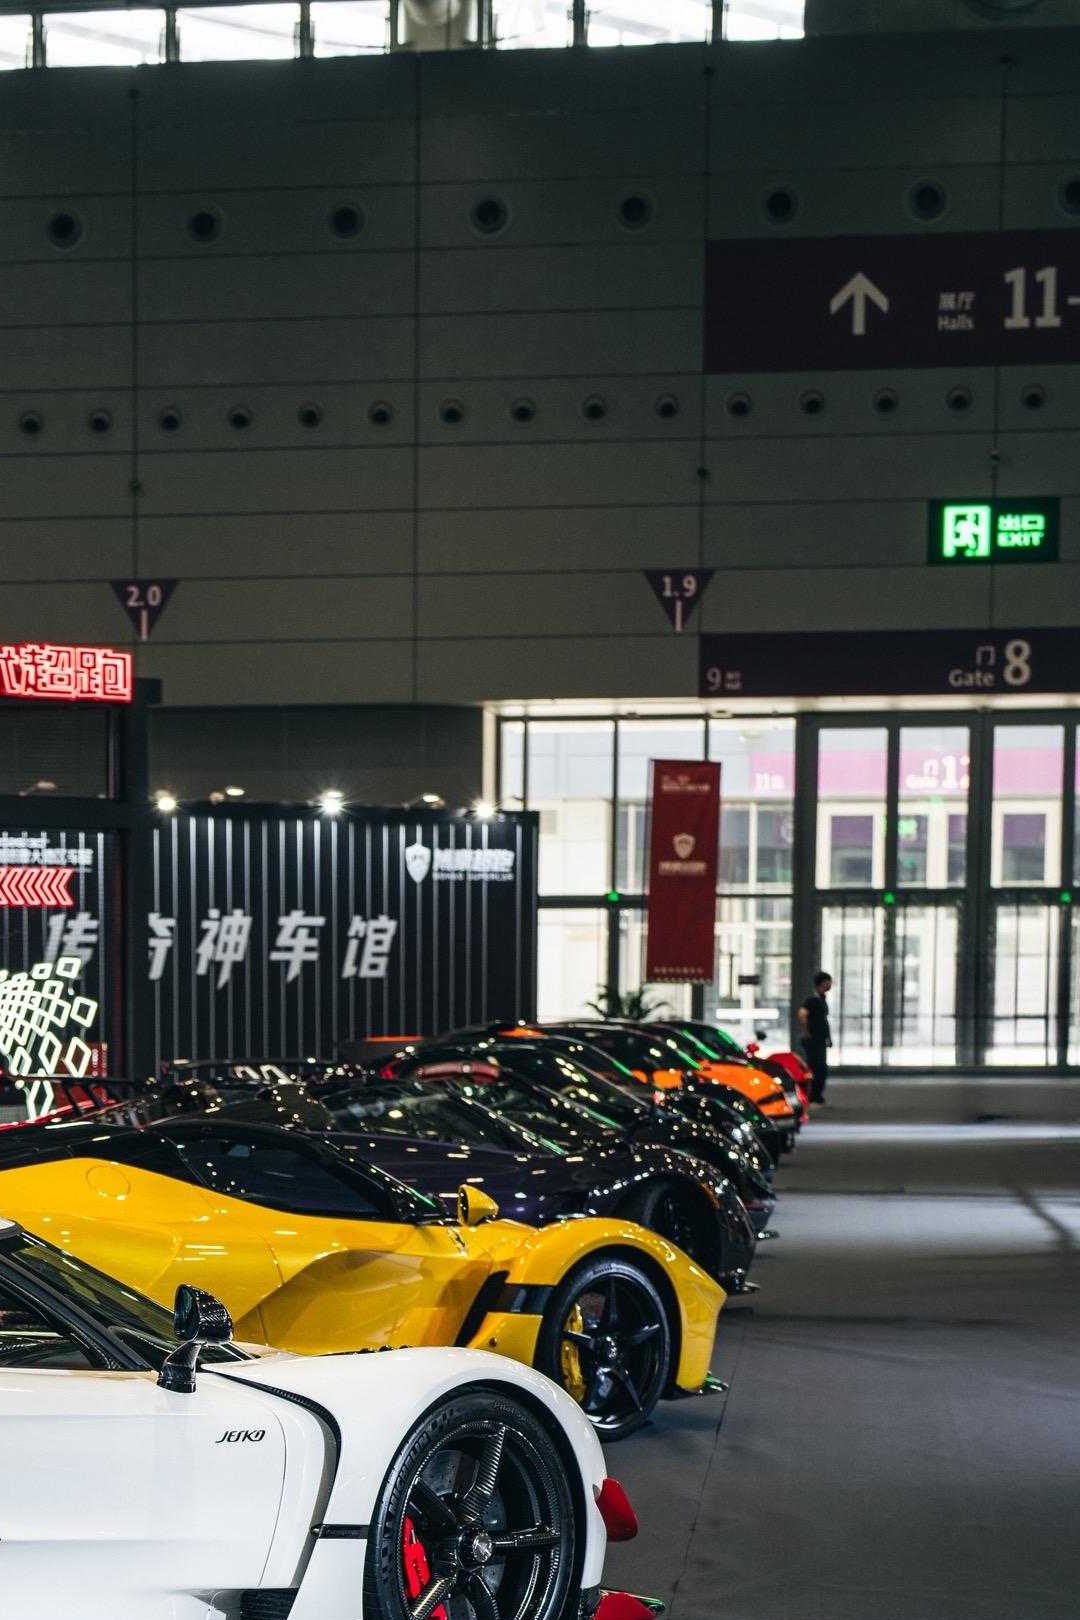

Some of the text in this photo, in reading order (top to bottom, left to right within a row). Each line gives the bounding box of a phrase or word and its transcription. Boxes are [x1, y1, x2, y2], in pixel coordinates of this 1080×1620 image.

[938, 314, 974, 331] Halls
[996, 532, 1045, 547] EXIT
[662, 573, 696, 598] 1.9
[126, 585, 161, 607] 2.0
[1003, 640, 1031, 686] 8
[949, 669, 995, 688] Gate
